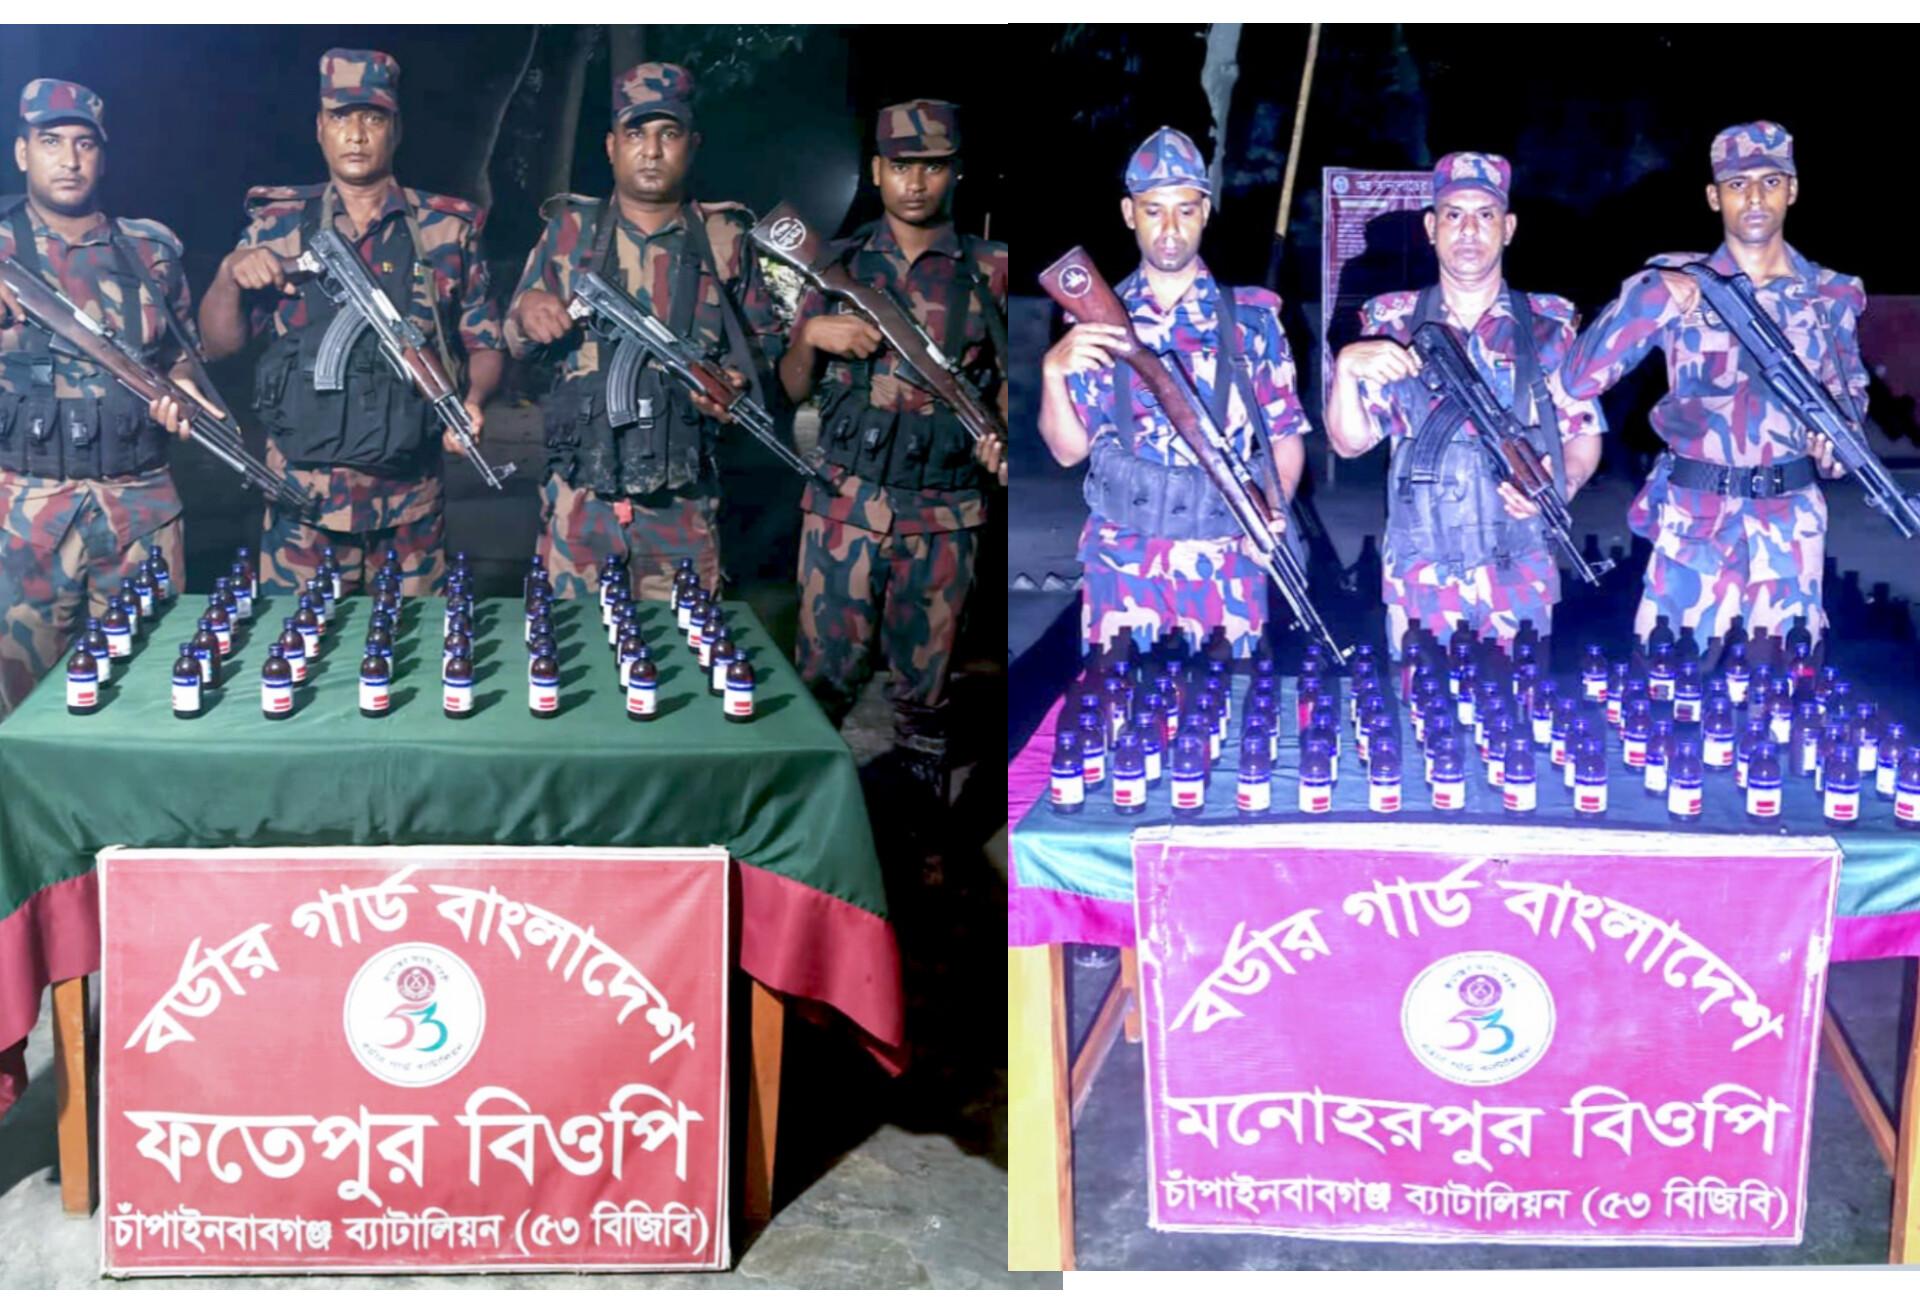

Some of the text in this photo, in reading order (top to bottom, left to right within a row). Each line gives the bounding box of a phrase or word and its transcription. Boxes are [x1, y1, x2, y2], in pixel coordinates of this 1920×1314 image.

[124, 864, 696, 1064] বর্ডার গার্ড বাংলাদেশ
[1168, 858, 1784, 1051] বর্ডার গার্ড বাংলাদেশ
[124, 1084, 704, 1207] ফতেপুর বিওপি
[1166, 1083, 1791, 1172] মনোহরপুর বিওপি
[109, 1201, 333, 1253] চাঁপাইনবাবগঞ্জ
[514, 1209, 581, 1257] (৫৩
[590, 1200, 710, 1255] বিজিবি)
[1160, 1169, 1392, 1214] চাঁপাইনবাবগঞ্জ
[1582, 1187, 1652, 1229] (৫৩
[1662, 1176, 1790, 1230] বিজিবি)
